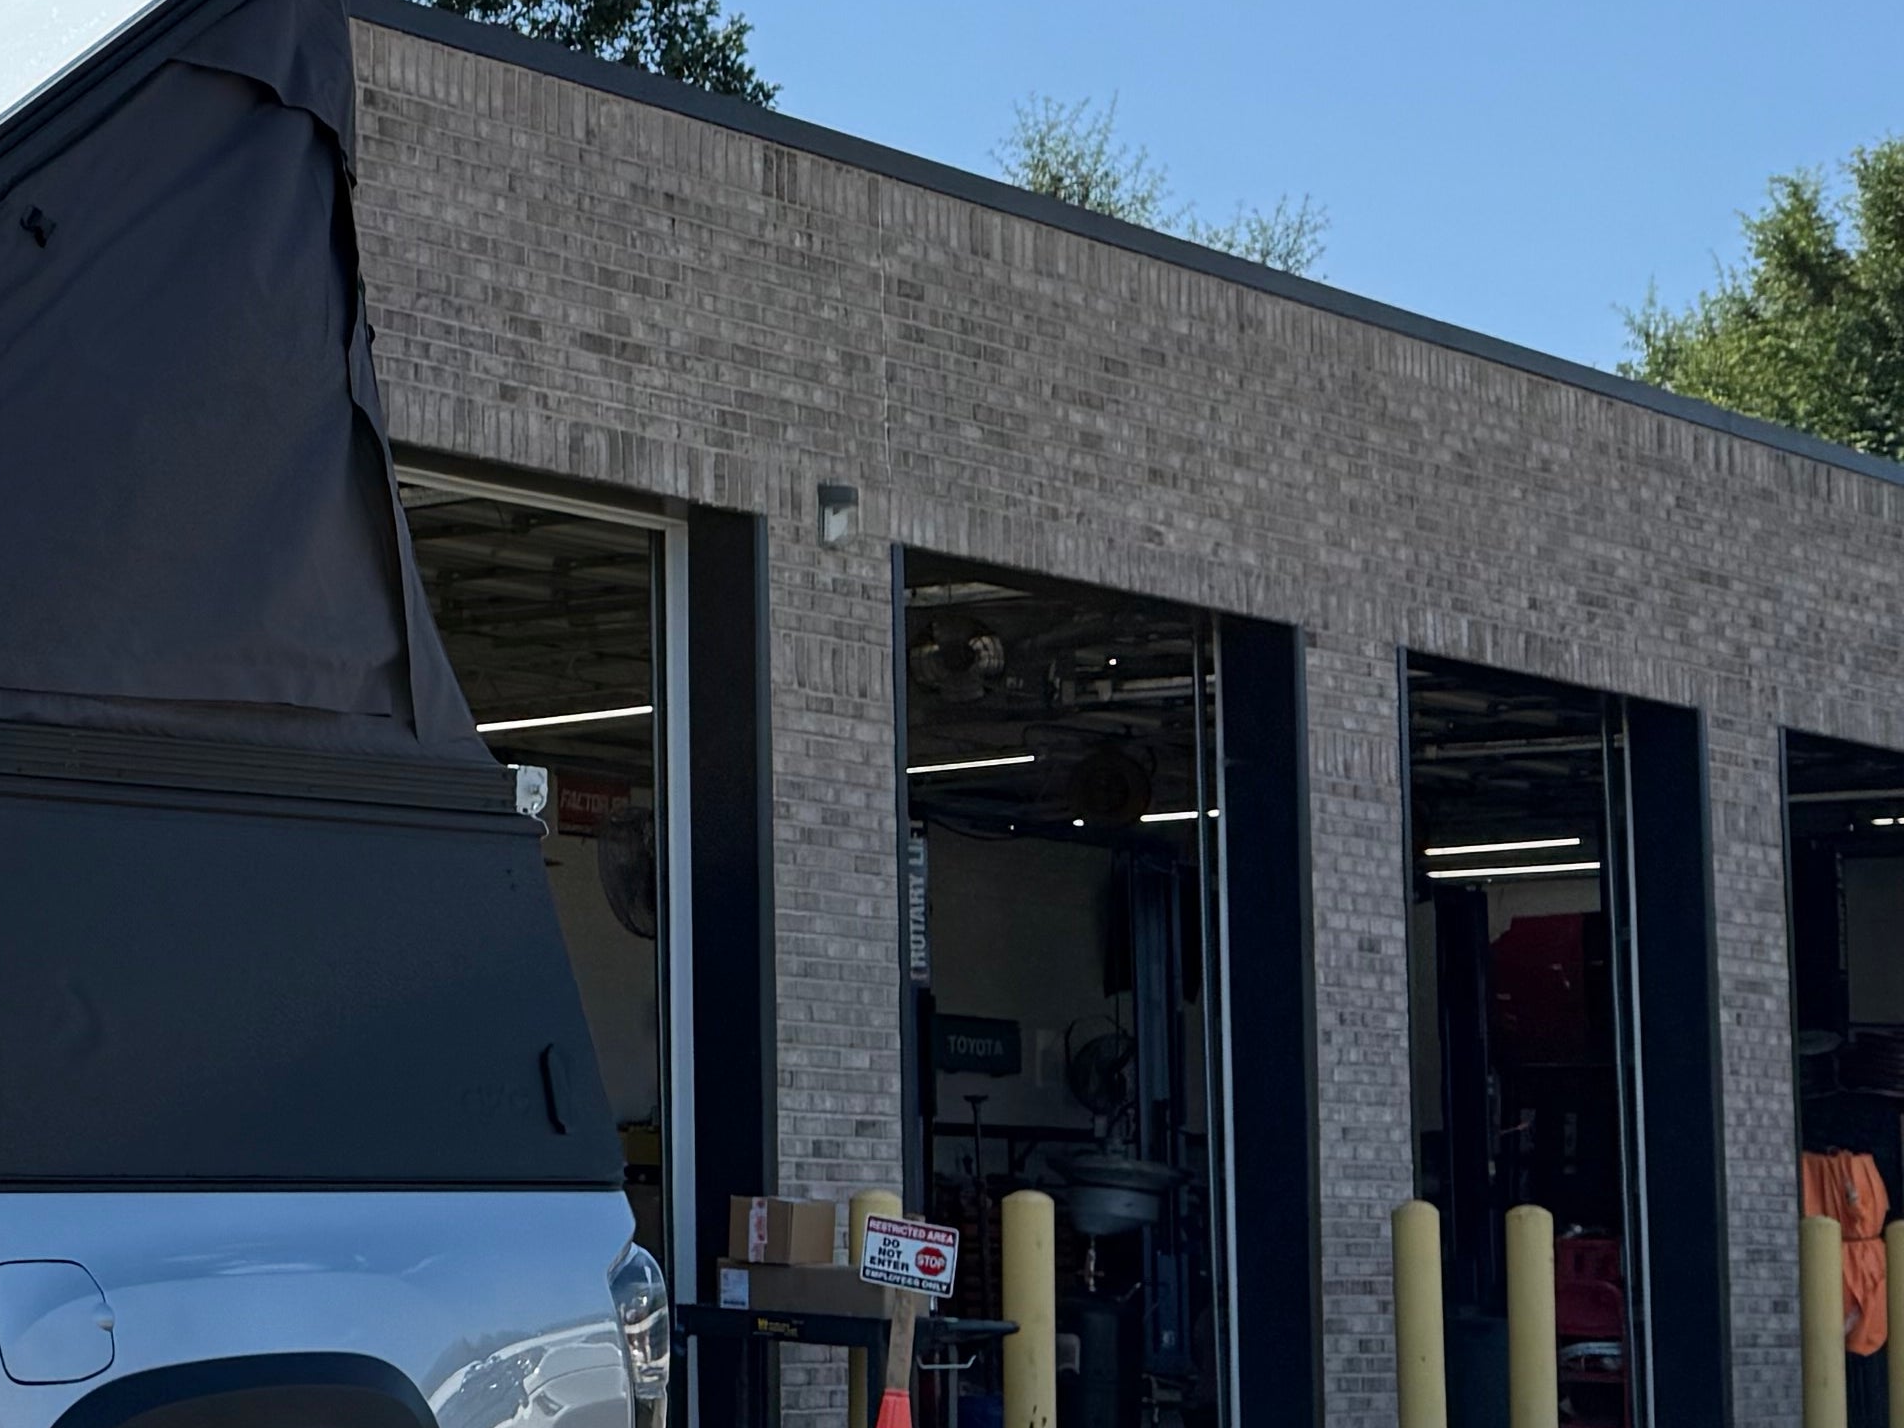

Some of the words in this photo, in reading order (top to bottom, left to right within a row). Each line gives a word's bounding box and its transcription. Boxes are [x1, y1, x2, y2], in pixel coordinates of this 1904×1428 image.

[909, 874, 927, 967] ROTARY
[948, 1035, 1005, 1057] TOYOTA
[869, 1219, 927, 1239] RESTRICTED
[927, 1230, 954, 1244] AREA
[883, 1238, 900, 1248] DO
[879, 1248, 903, 1258] NOT
[917, 1254, 945, 1269] STOP
[869, 1256, 910, 1273] ENTER
[864, 1269, 920, 1287] EMPLOYEES
[921, 1280, 948, 1292] ONLY
